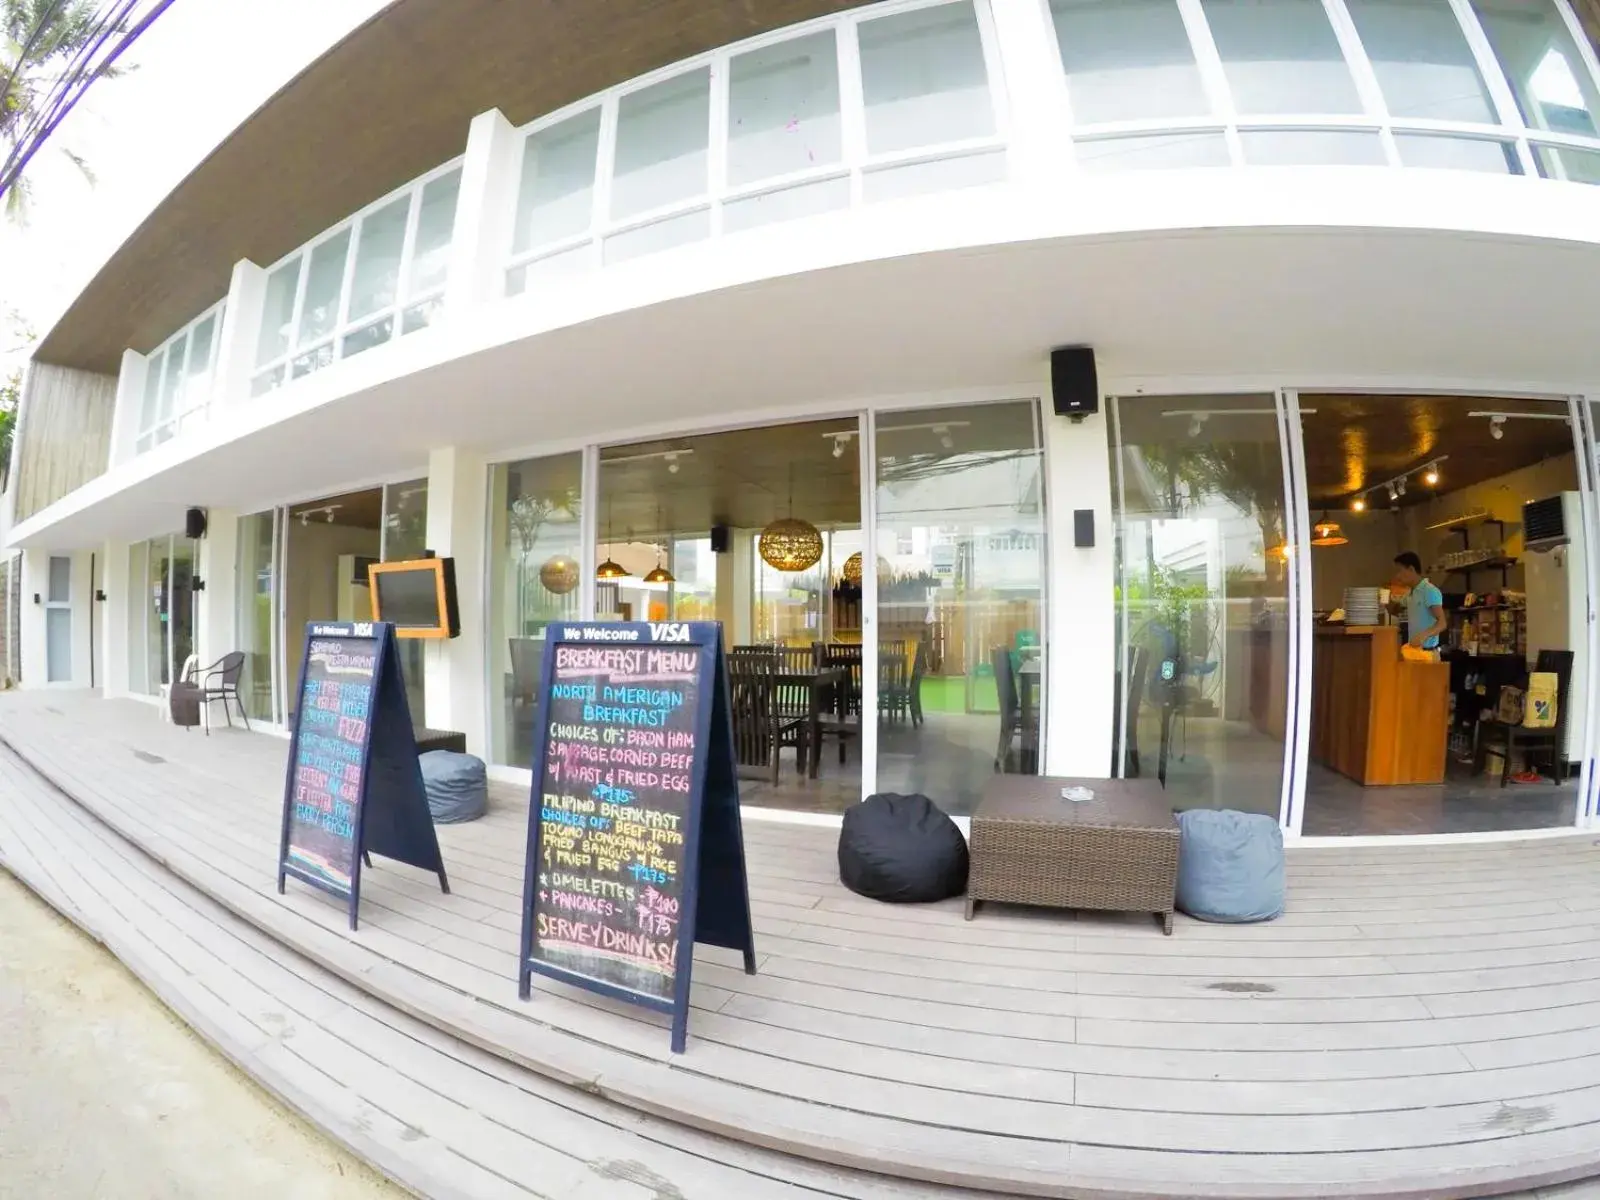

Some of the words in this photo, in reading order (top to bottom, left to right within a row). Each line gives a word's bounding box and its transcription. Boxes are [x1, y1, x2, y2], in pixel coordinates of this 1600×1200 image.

[353, 622, 373, 637] VISA
[564, 627, 581, 640] We
[583, 626, 639, 641] Welcome
[649, 623, 690, 642] VISA
[556, 647, 644, 673] BREAKFAST
[647, 652, 697, 674] MENU
[552, 684, 596, 699] NORTH
[603, 686, 683, 707] AMERICAN
[583, 705, 668, 727] BREAKFAST
[550, 722, 599, 742] CHOICES
[626, 729, 665, 748] BACON
[609, 747, 658, 768] CORNED
[660, 751, 694, 770] BEEF
[617, 768, 659, 787] FRIED
[661, 773, 690, 793] EGG
[541, 807, 587, 828] CHOICES
[615, 820, 647, 838] BEEF
[649, 827, 684, 846] TAPA
[600, 803, 681, 829] BREAKFAST
[543, 834, 575, 851] FRIED
[582, 840, 632, 862] BANGUS
[556, 849, 592, 867] FRIED
[552, 871, 636, 902] OMELETTES
